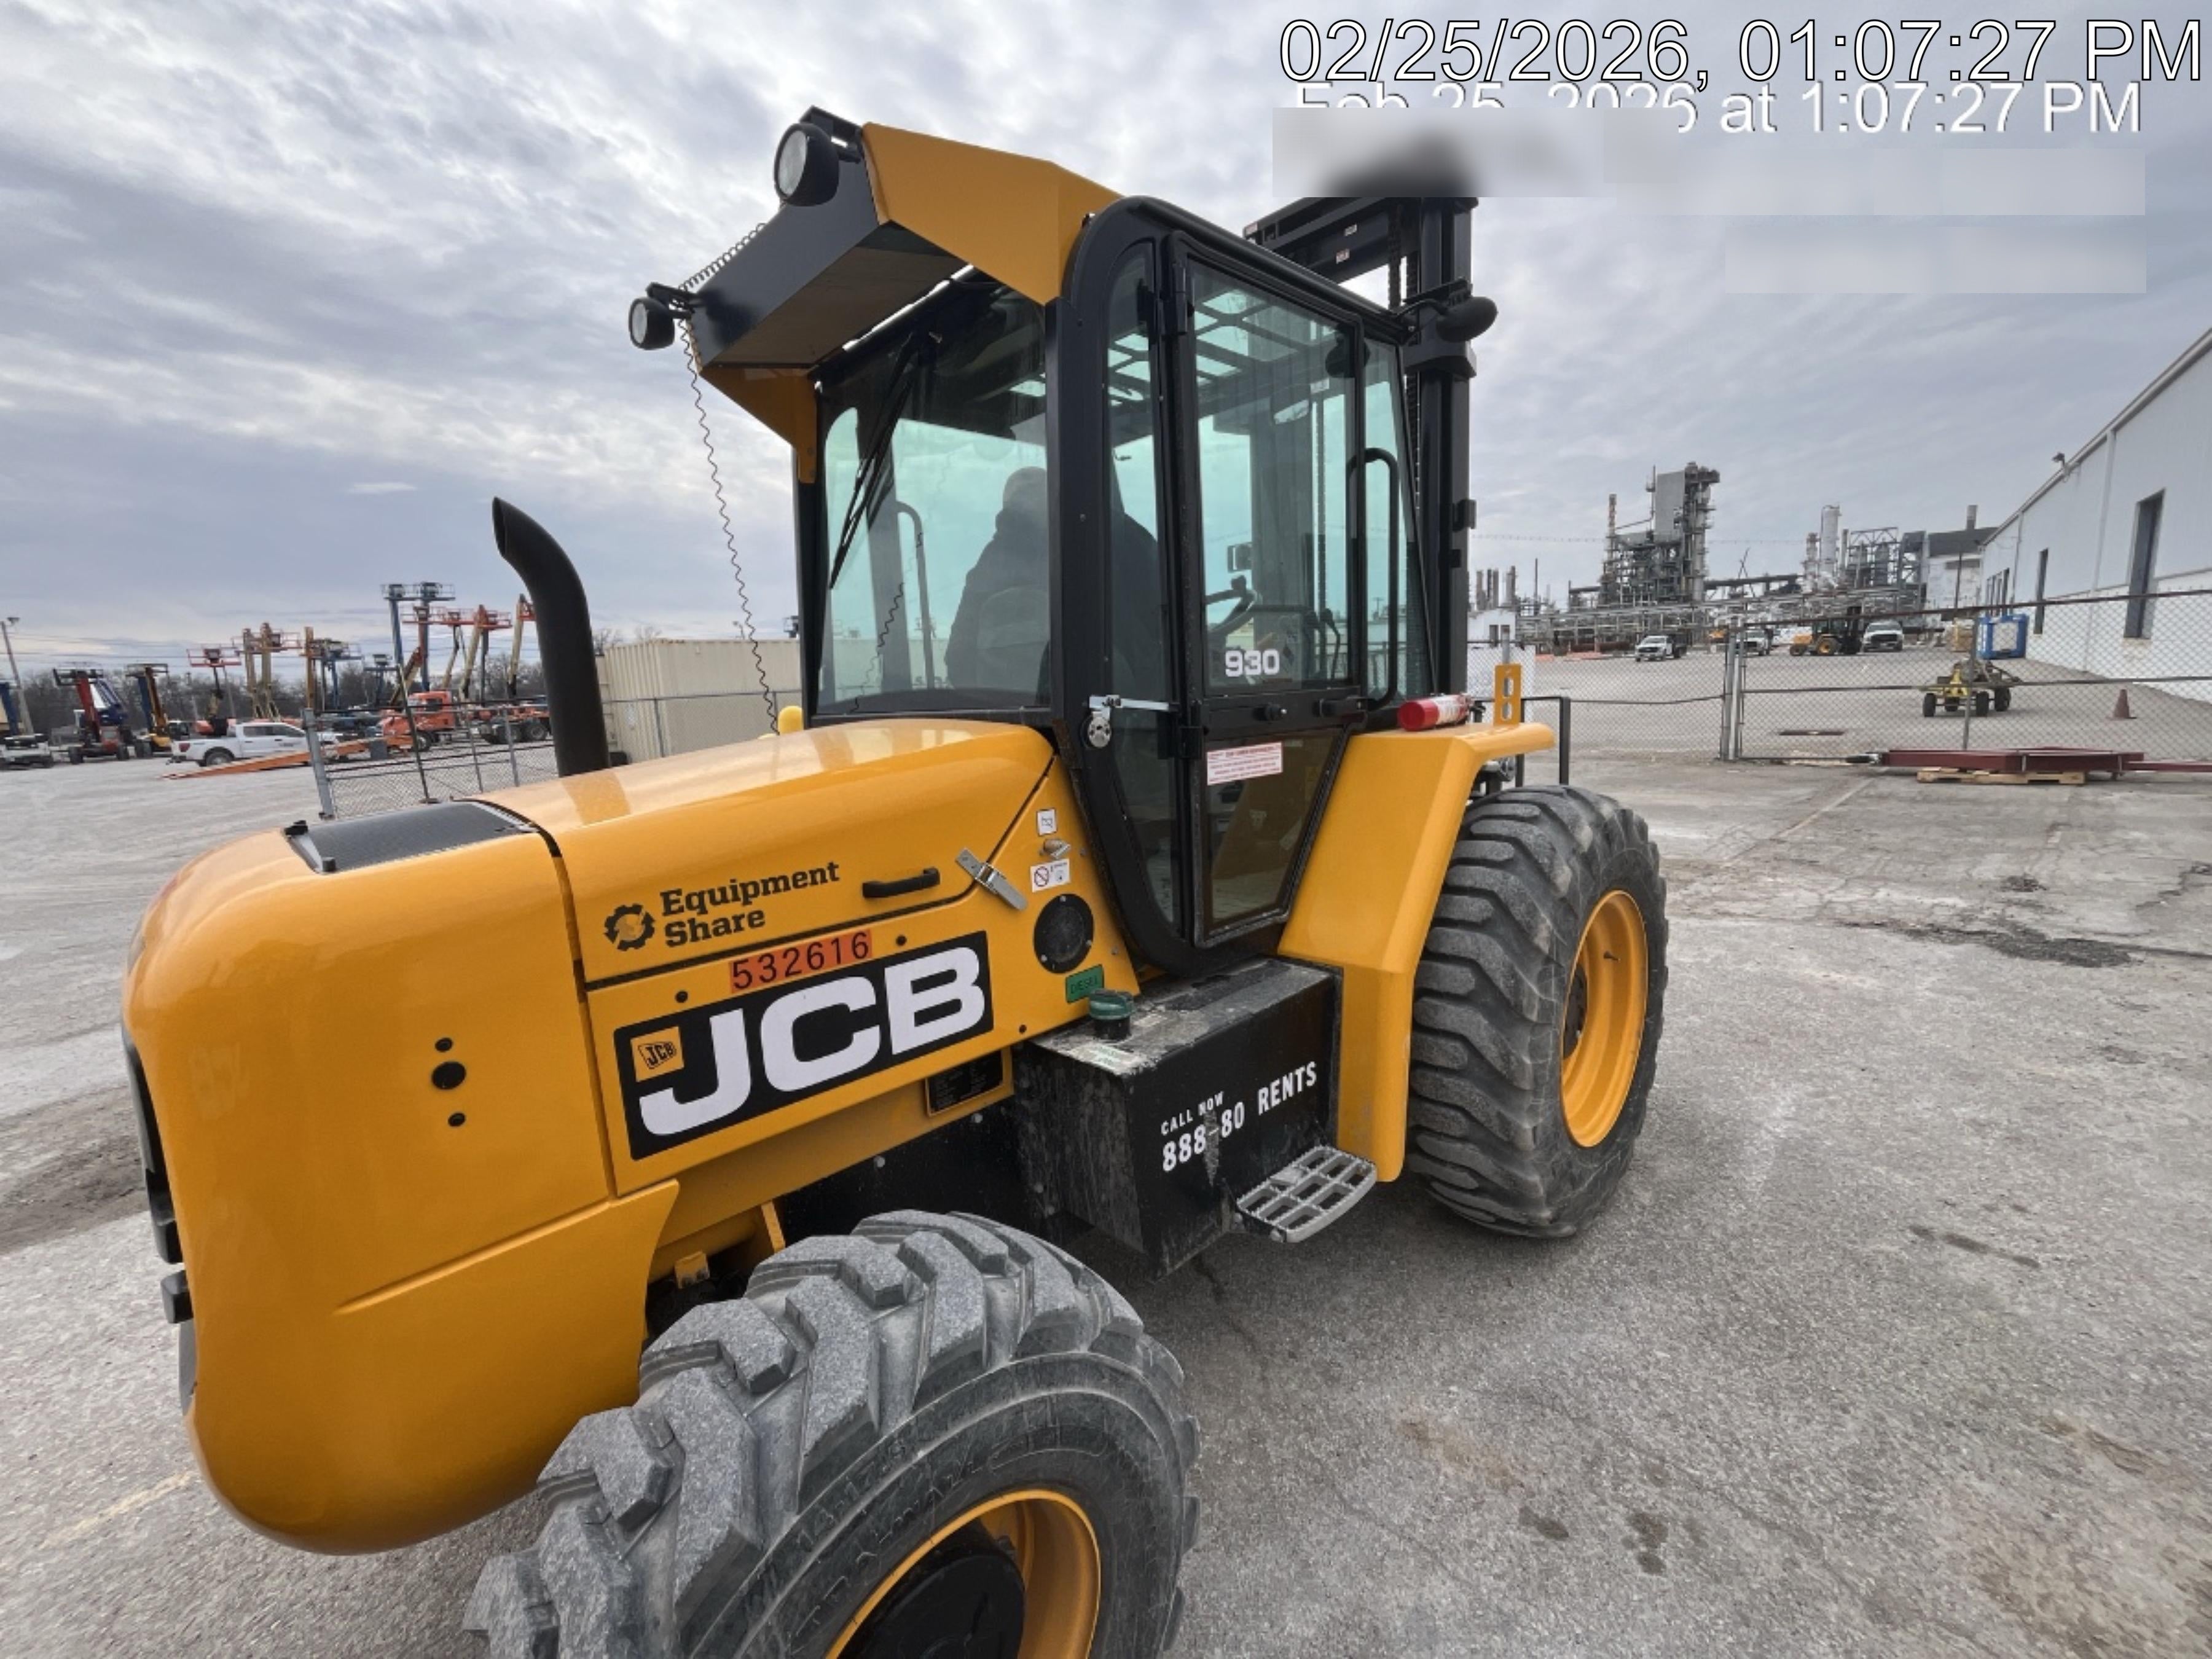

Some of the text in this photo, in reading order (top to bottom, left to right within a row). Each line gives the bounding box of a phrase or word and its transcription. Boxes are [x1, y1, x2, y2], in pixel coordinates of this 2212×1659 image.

[1225, 648, 1280, 677] 930
[660, 861, 841, 917] Equipment
[664, 907, 766, 949] Share
[732, 931, 869, 989] 532616
[639, 946, 986, 1137] JCB
[644, 1042, 675, 1067] JCB
[1161, 1091, 1223, 1135] CALL NOW
[1258, 1061, 1317, 1116] RENTS
